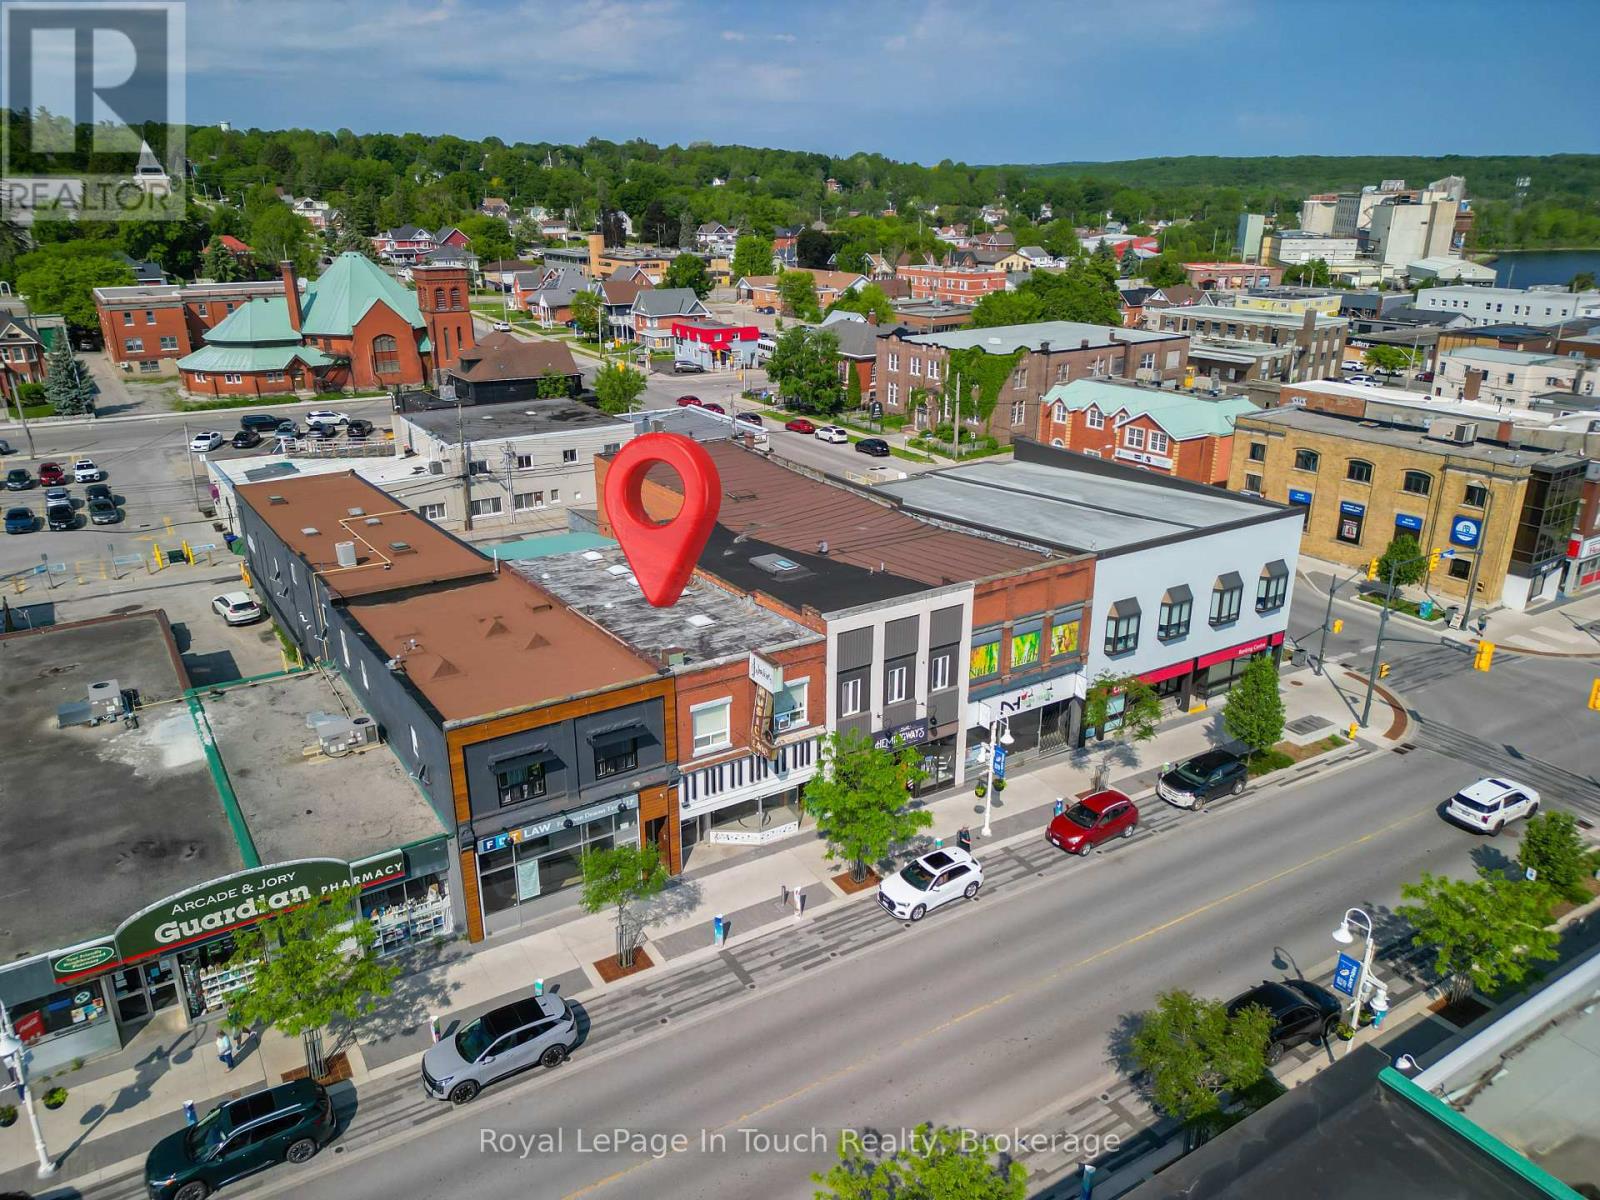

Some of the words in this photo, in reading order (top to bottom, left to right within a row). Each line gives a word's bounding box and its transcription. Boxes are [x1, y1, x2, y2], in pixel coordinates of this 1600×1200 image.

[524, 822, 553, 839] LAW
[171, 888, 239, 916] ARCADE
[241, 882, 254, 894] &
[257, 871, 296, 891] JORY
[320, 861, 404, 896] PHARMACY
